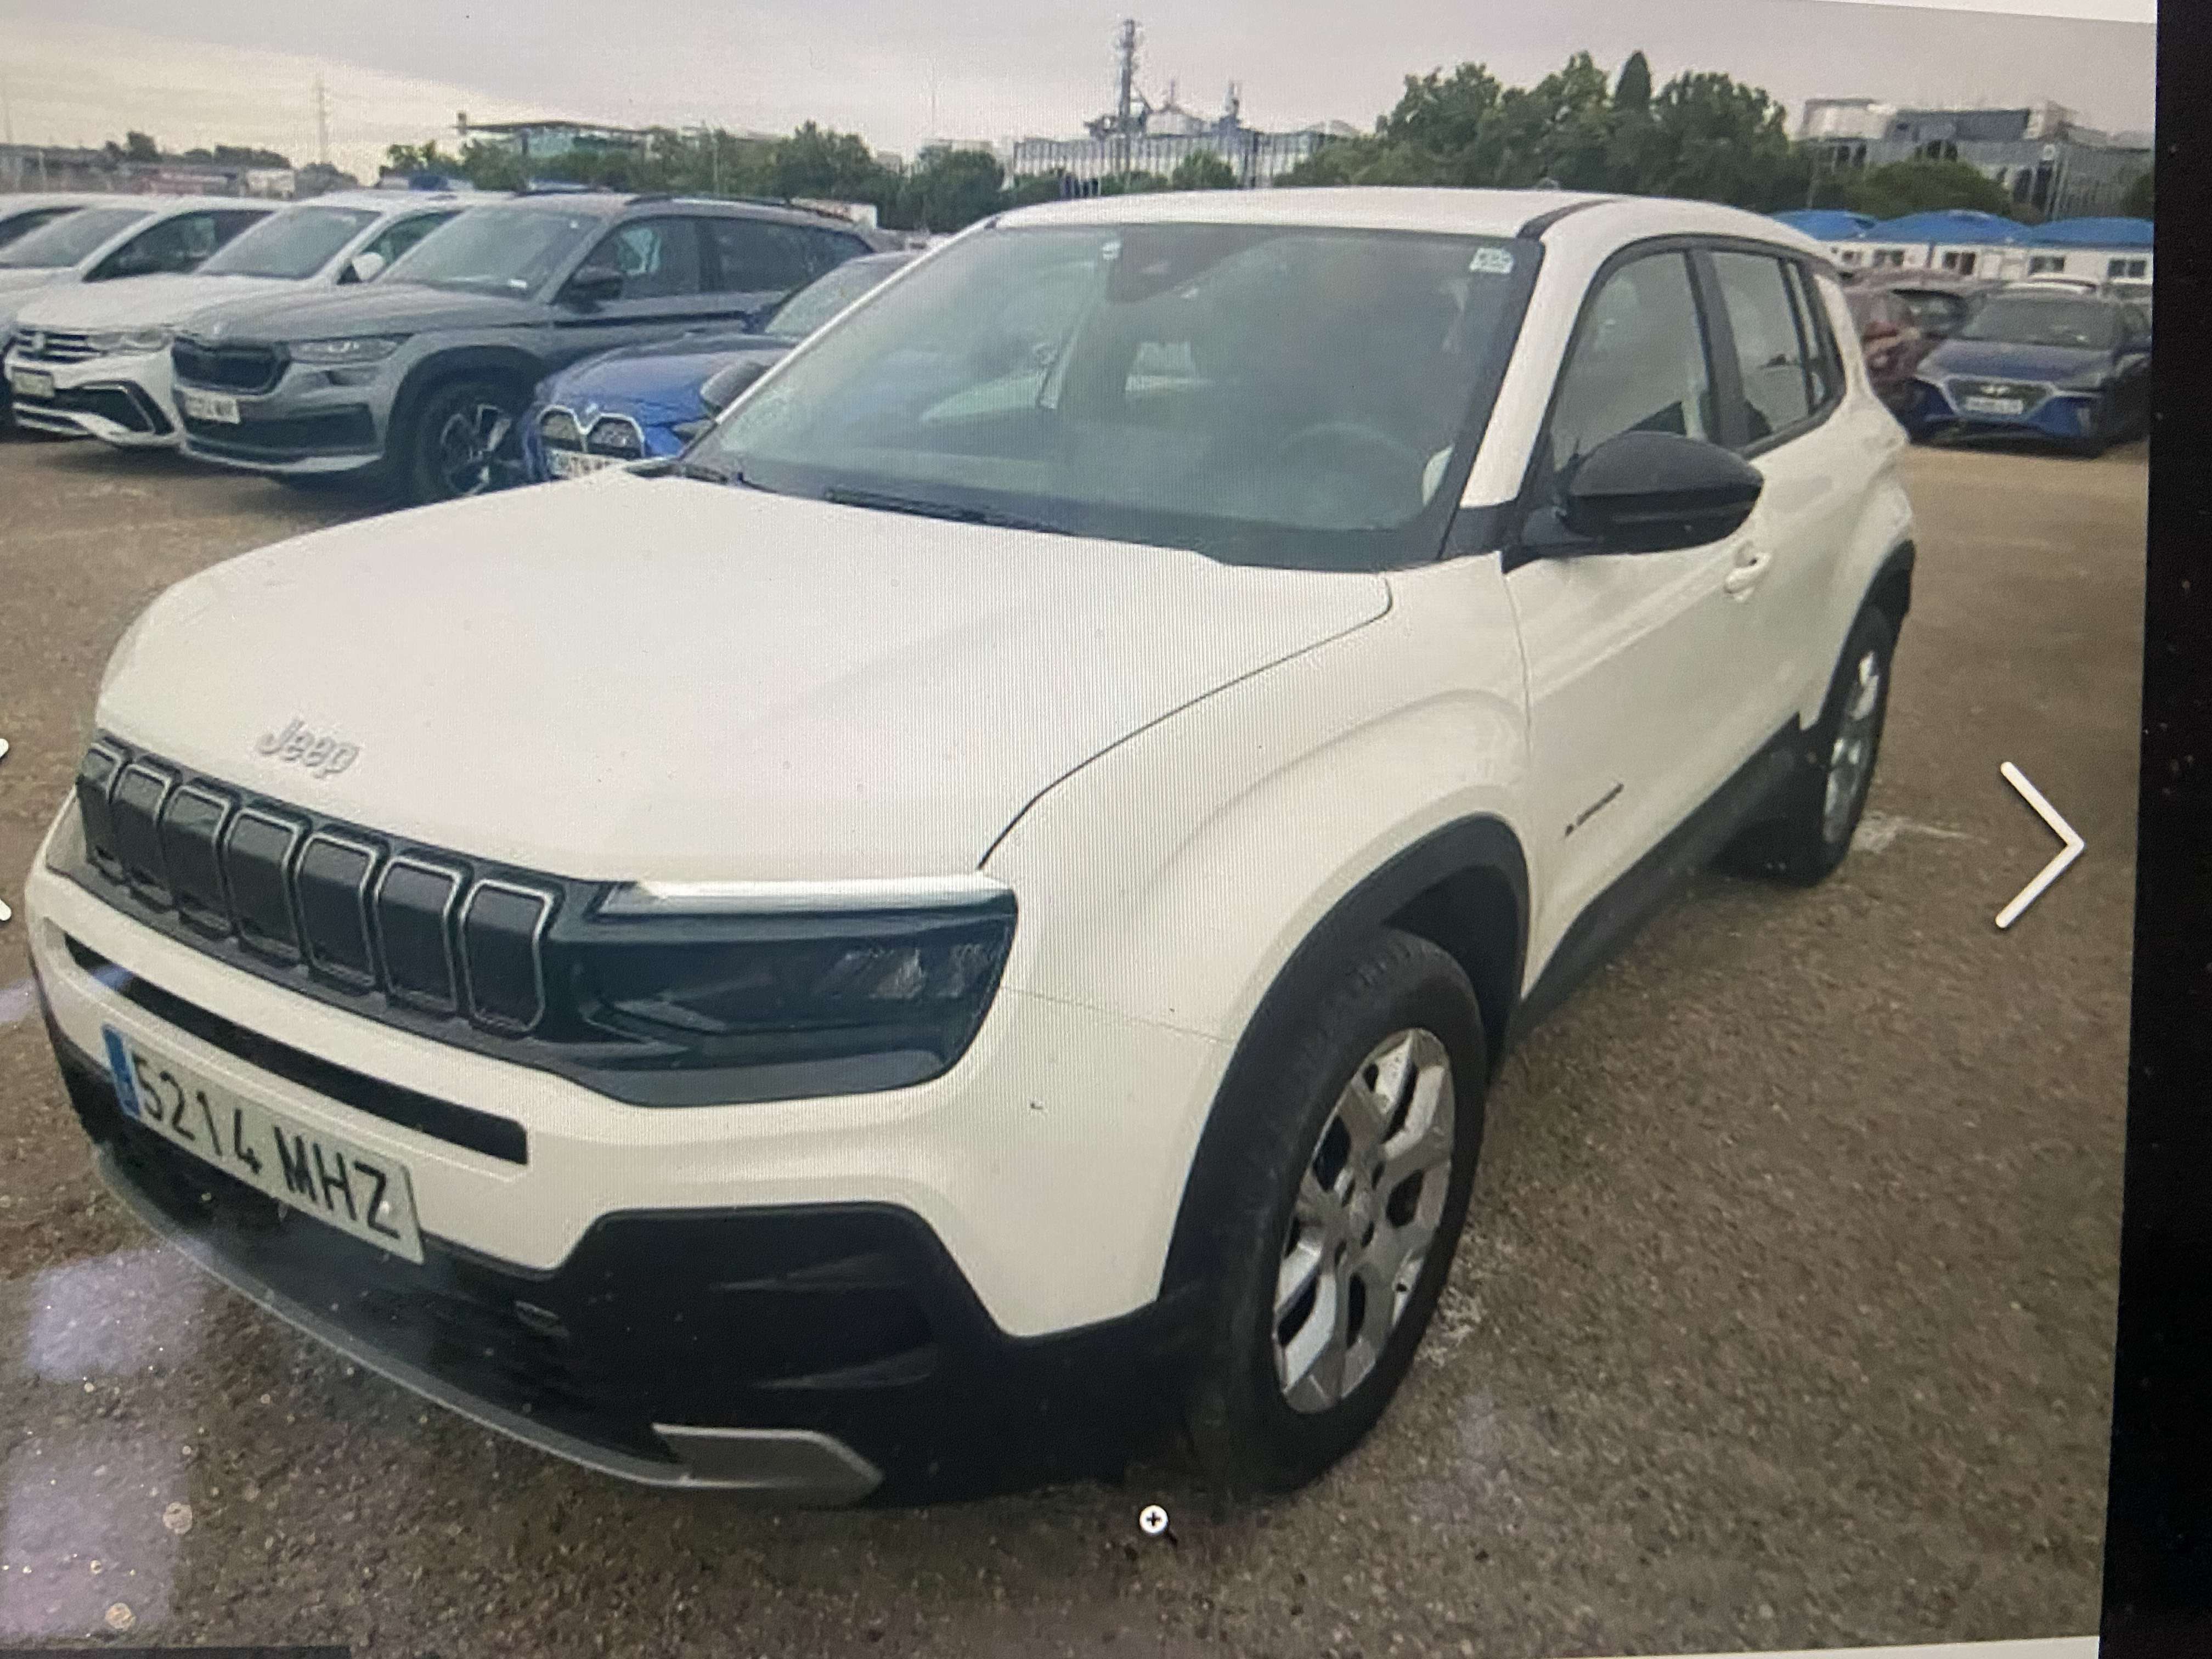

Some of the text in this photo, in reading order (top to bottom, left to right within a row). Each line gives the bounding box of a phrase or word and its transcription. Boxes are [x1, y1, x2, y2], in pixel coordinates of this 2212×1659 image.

[255, 718, 360, 779] Jeep
[132, 1053, 400, 1239] 5214 MHZ
